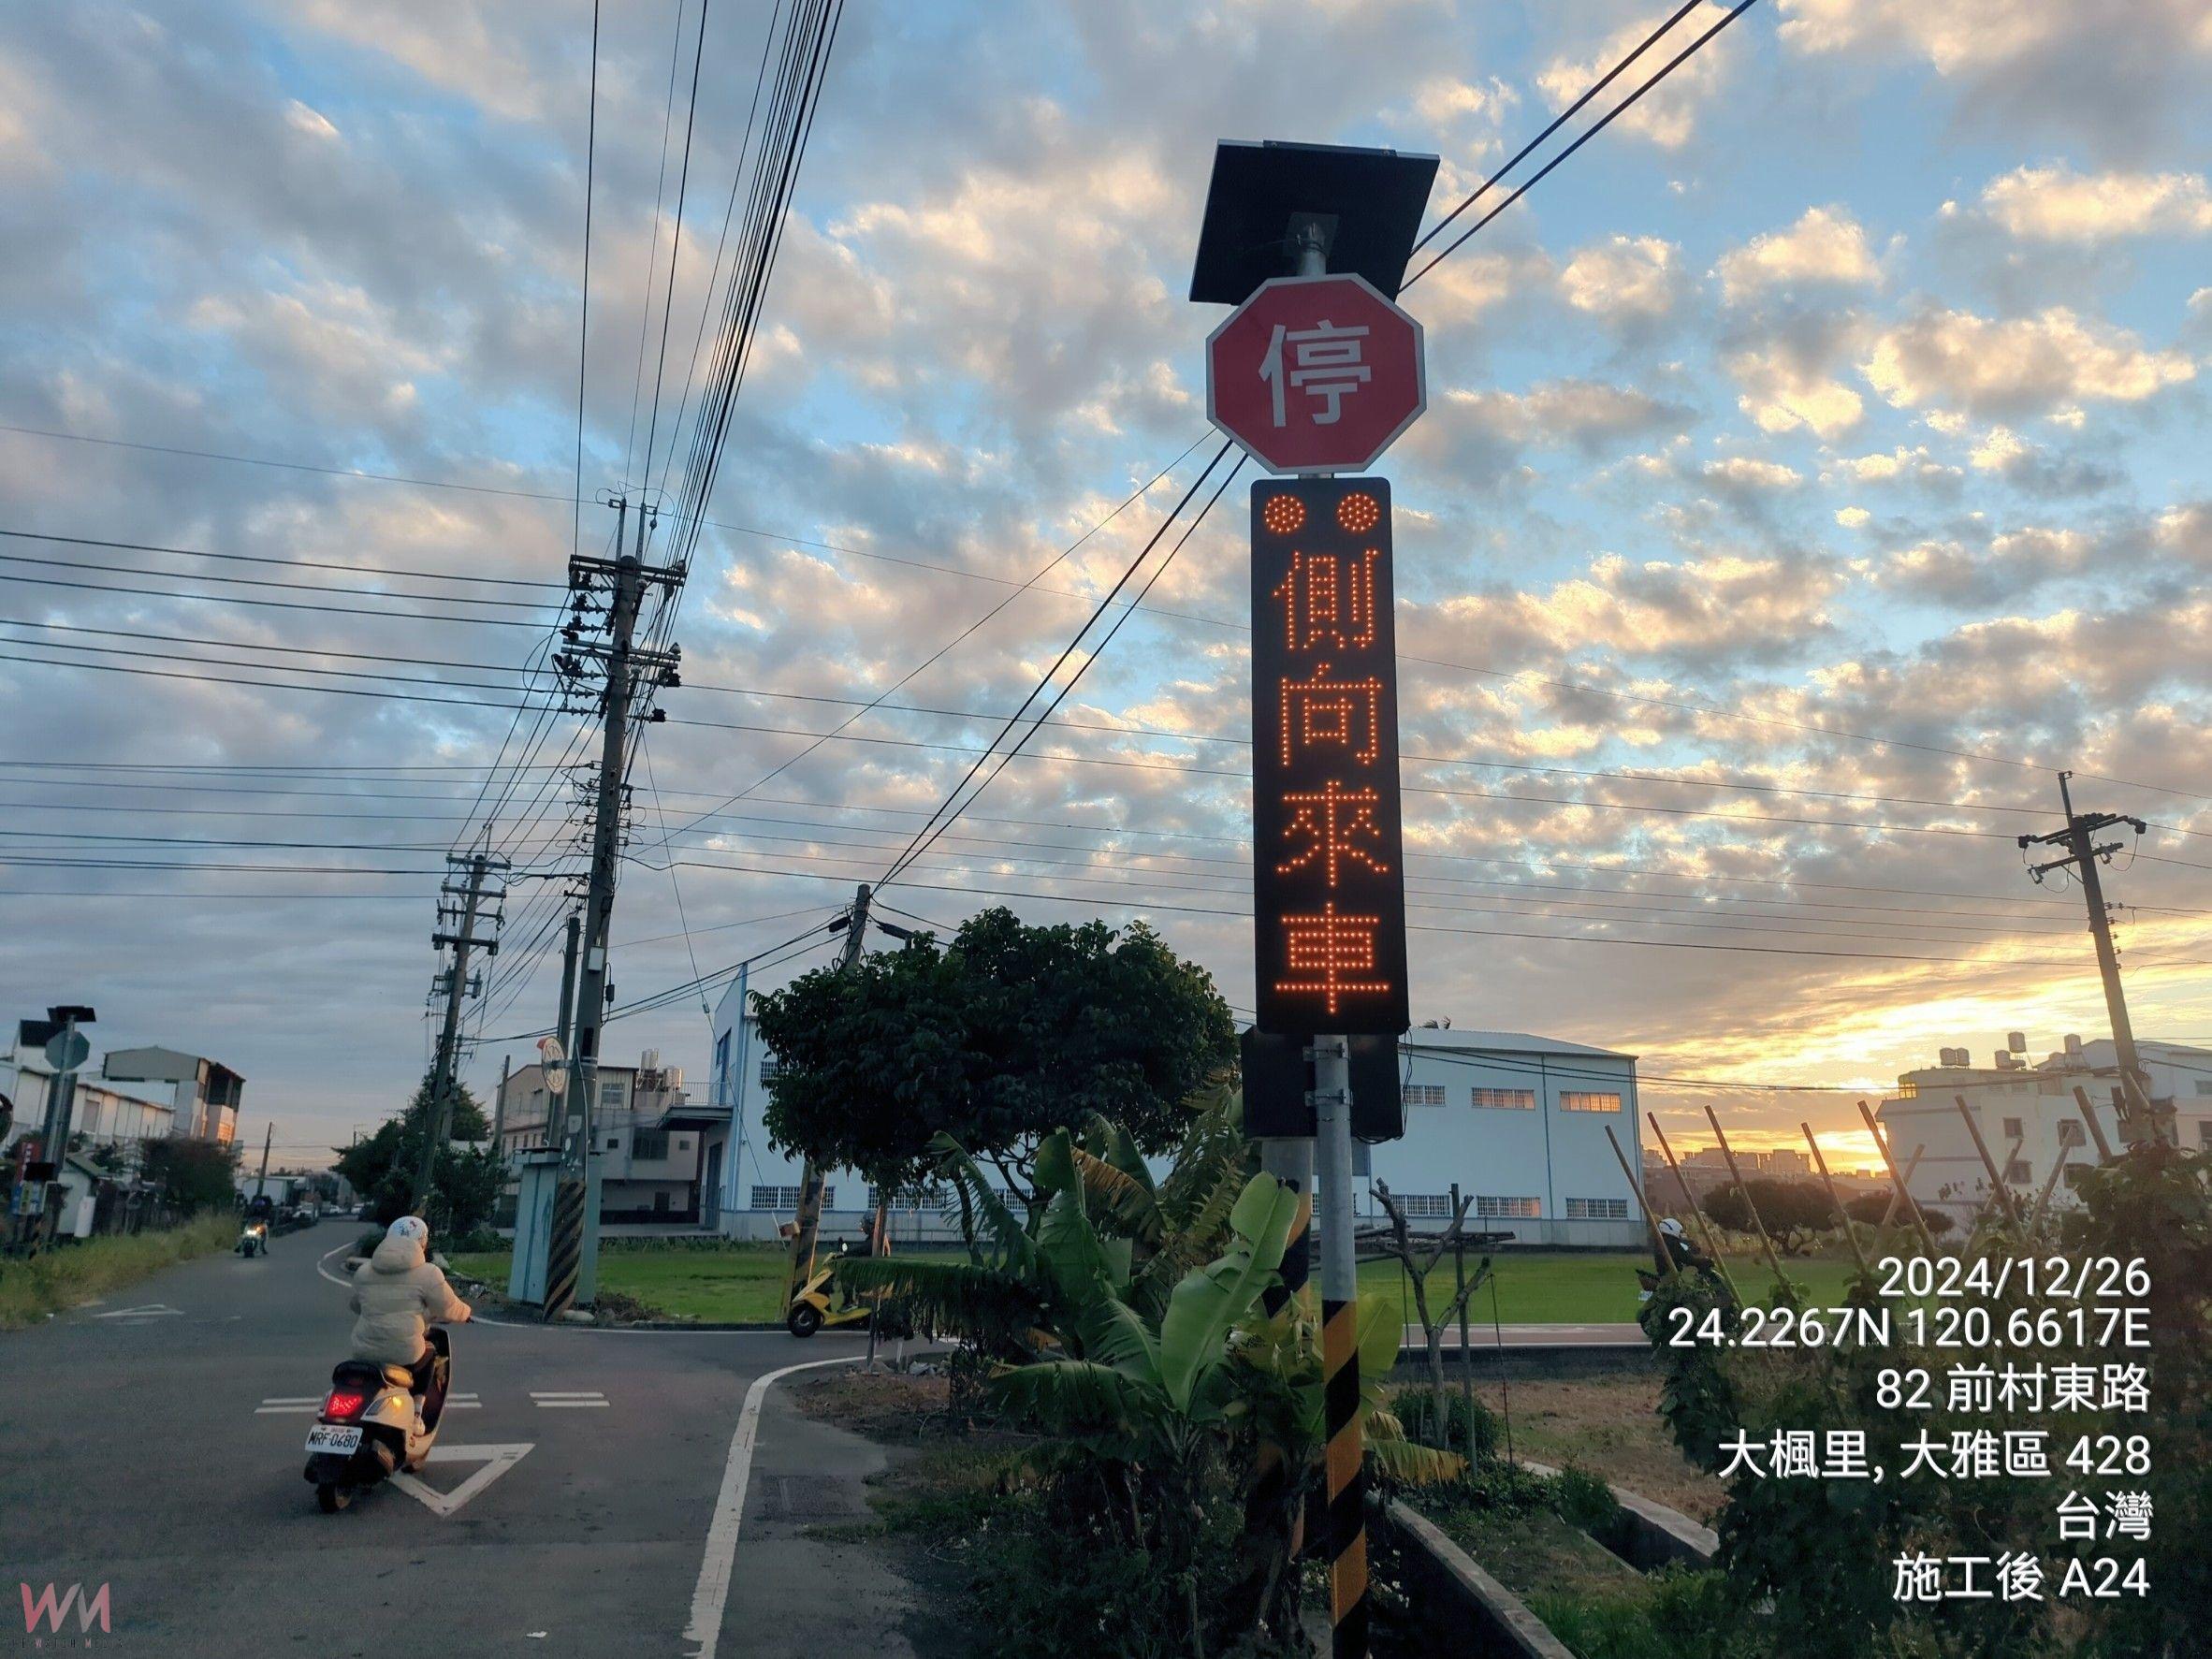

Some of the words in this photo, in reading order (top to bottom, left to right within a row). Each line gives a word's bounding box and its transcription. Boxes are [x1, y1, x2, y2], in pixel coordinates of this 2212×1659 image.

[1259, 319, 1371, 427] 停
[1273, 548, 1390, 1014] 側向來車
